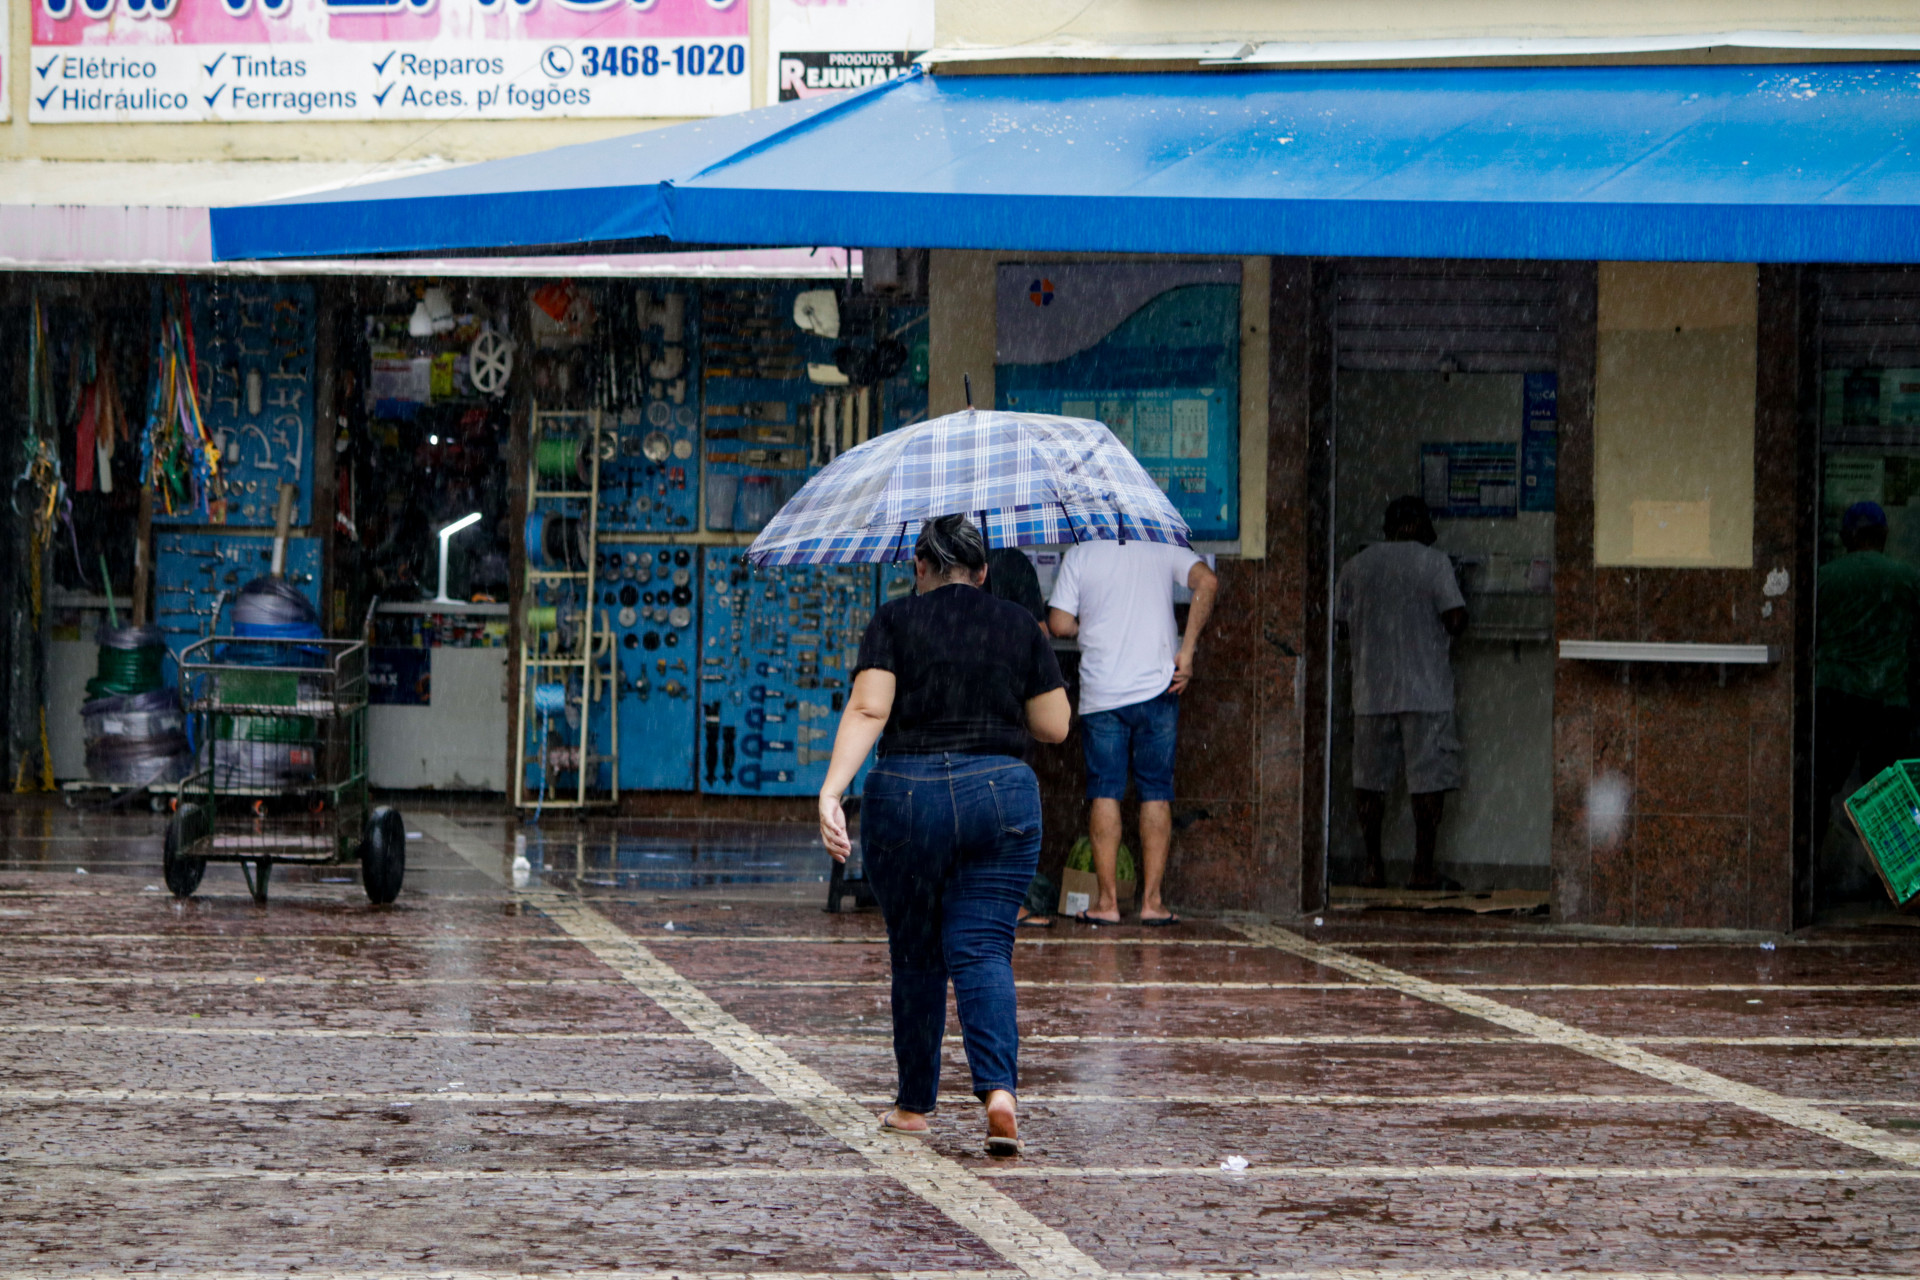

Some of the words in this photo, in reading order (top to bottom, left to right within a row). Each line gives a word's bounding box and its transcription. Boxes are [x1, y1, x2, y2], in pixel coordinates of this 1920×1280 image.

[63, 56, 157, 79] Elétrico
[231, 55, 307, 78] Tintas
[401, 53, 504, 80] Reparos
[581, 44, 745, 77] 3468-1020
[829, 53, 894, 66] PRODUTOS
[63, 88, 188, 111] Hidráulico
[232, 87, 357, 114] Ferragens
[401, 85, 468, 107] Aces.
[477, 84, 500, 111] p/
[507, 83, 591, 111] fogões
